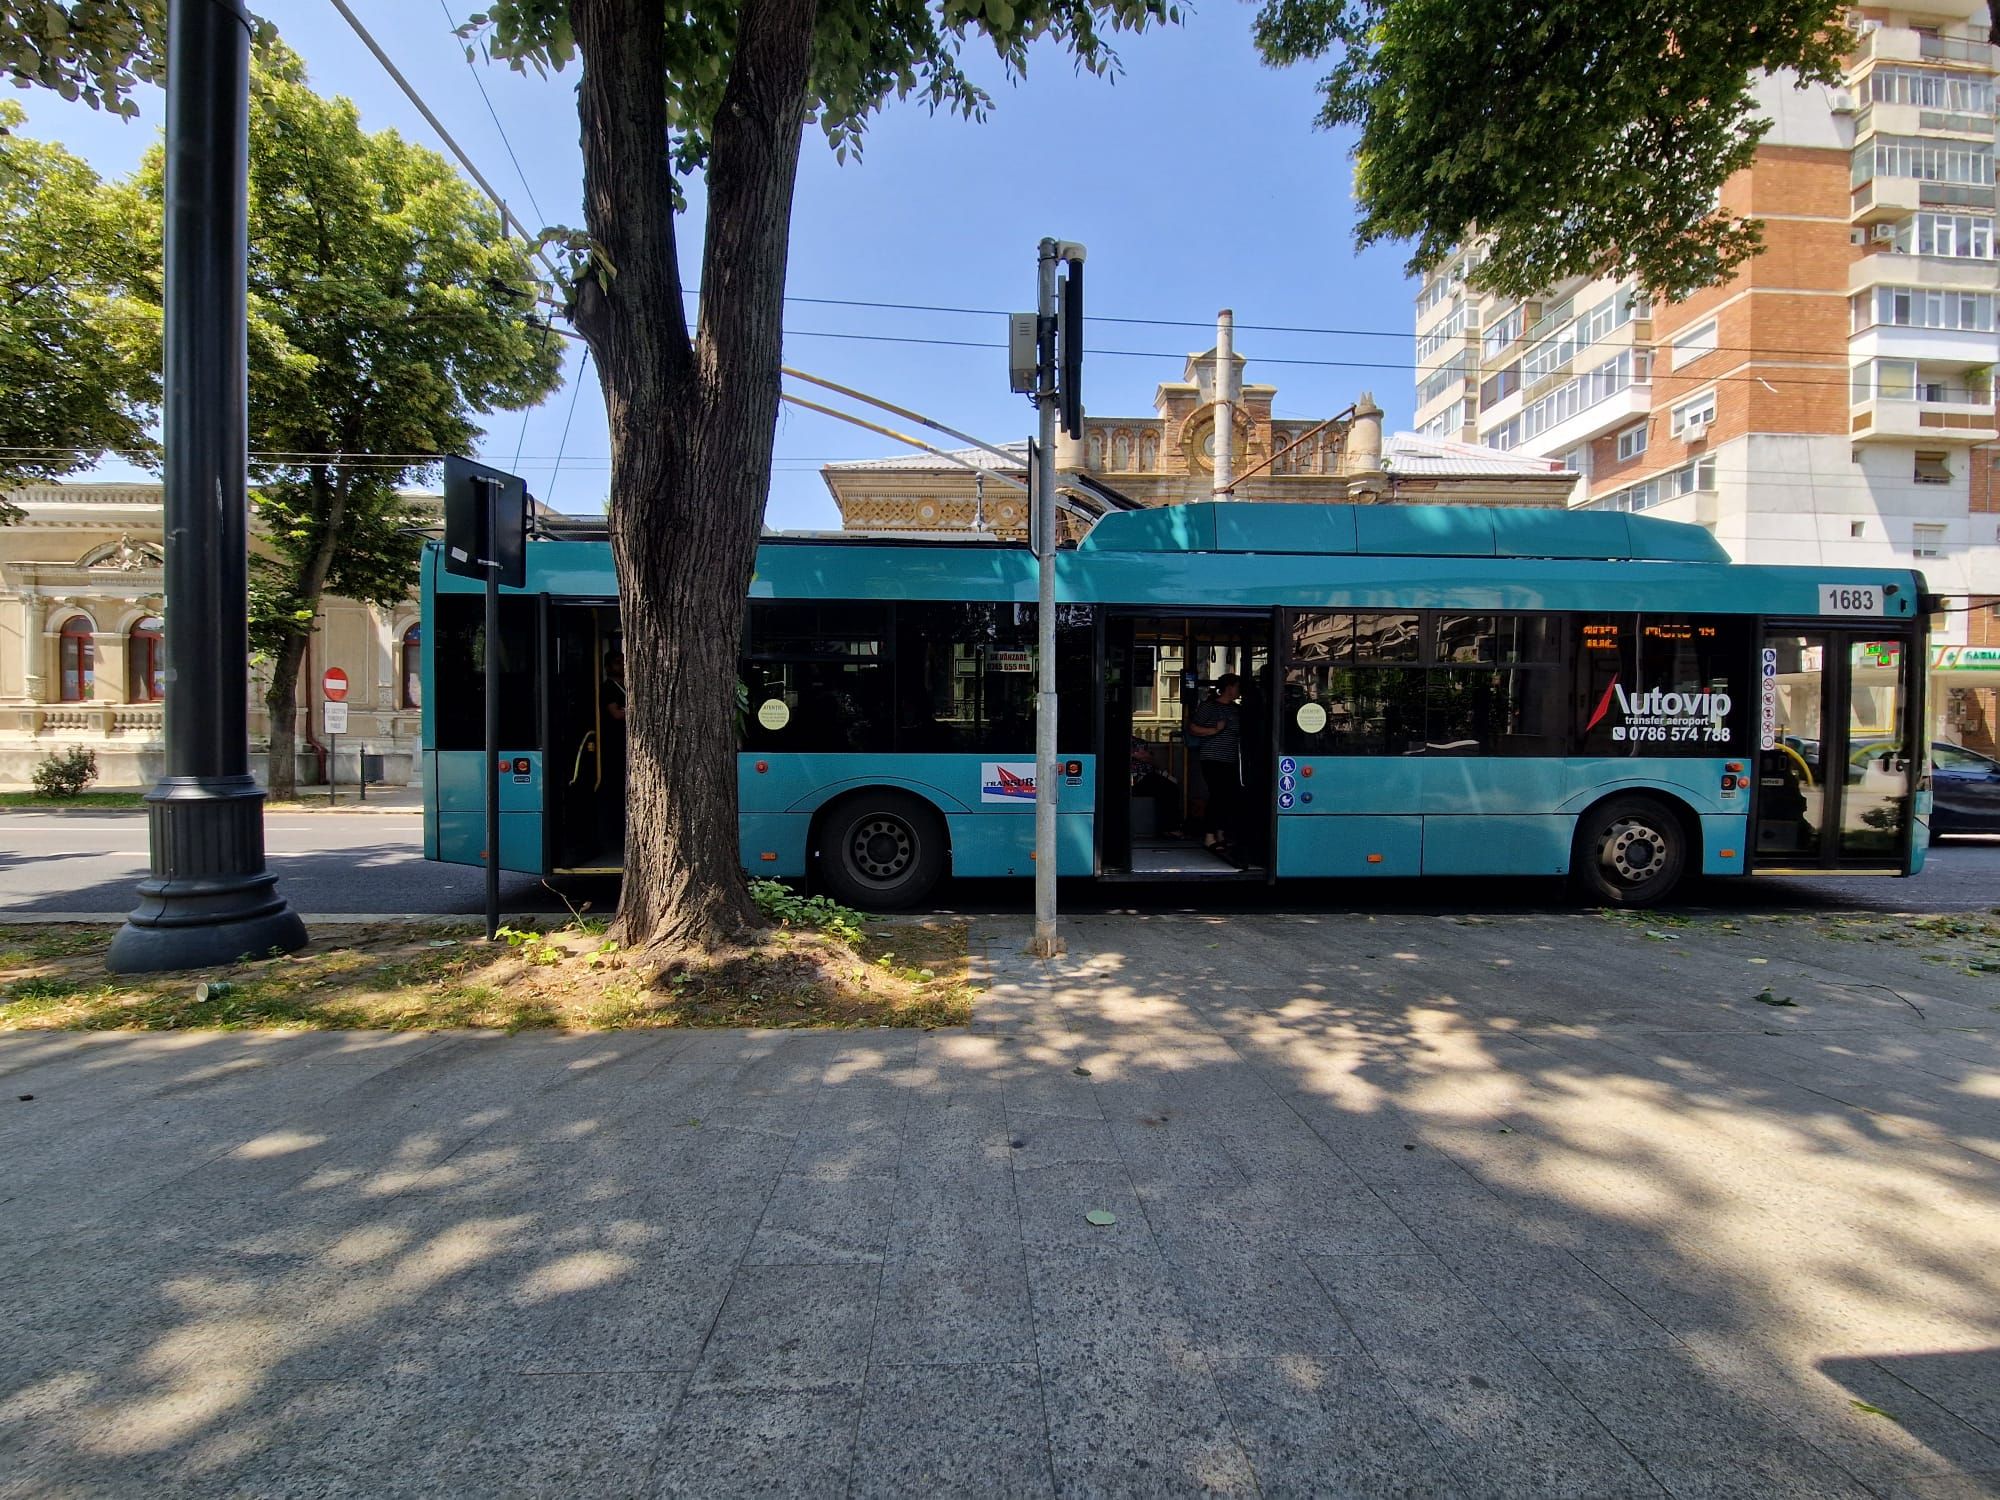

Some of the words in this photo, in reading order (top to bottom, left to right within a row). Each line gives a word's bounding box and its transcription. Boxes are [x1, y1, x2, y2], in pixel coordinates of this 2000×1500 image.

[1829, 589, 1874, 610] 1683
[1585, 672, 1732, 726] Autovip
[1625, 715, 1664, 725] transfer
[1666, 716, 1709, 726] aeroport
[1629, 726, 1667, 741] 0786
[1670, 727, 1699, 741] 574
[1702, 727, 1731, 742] 788
